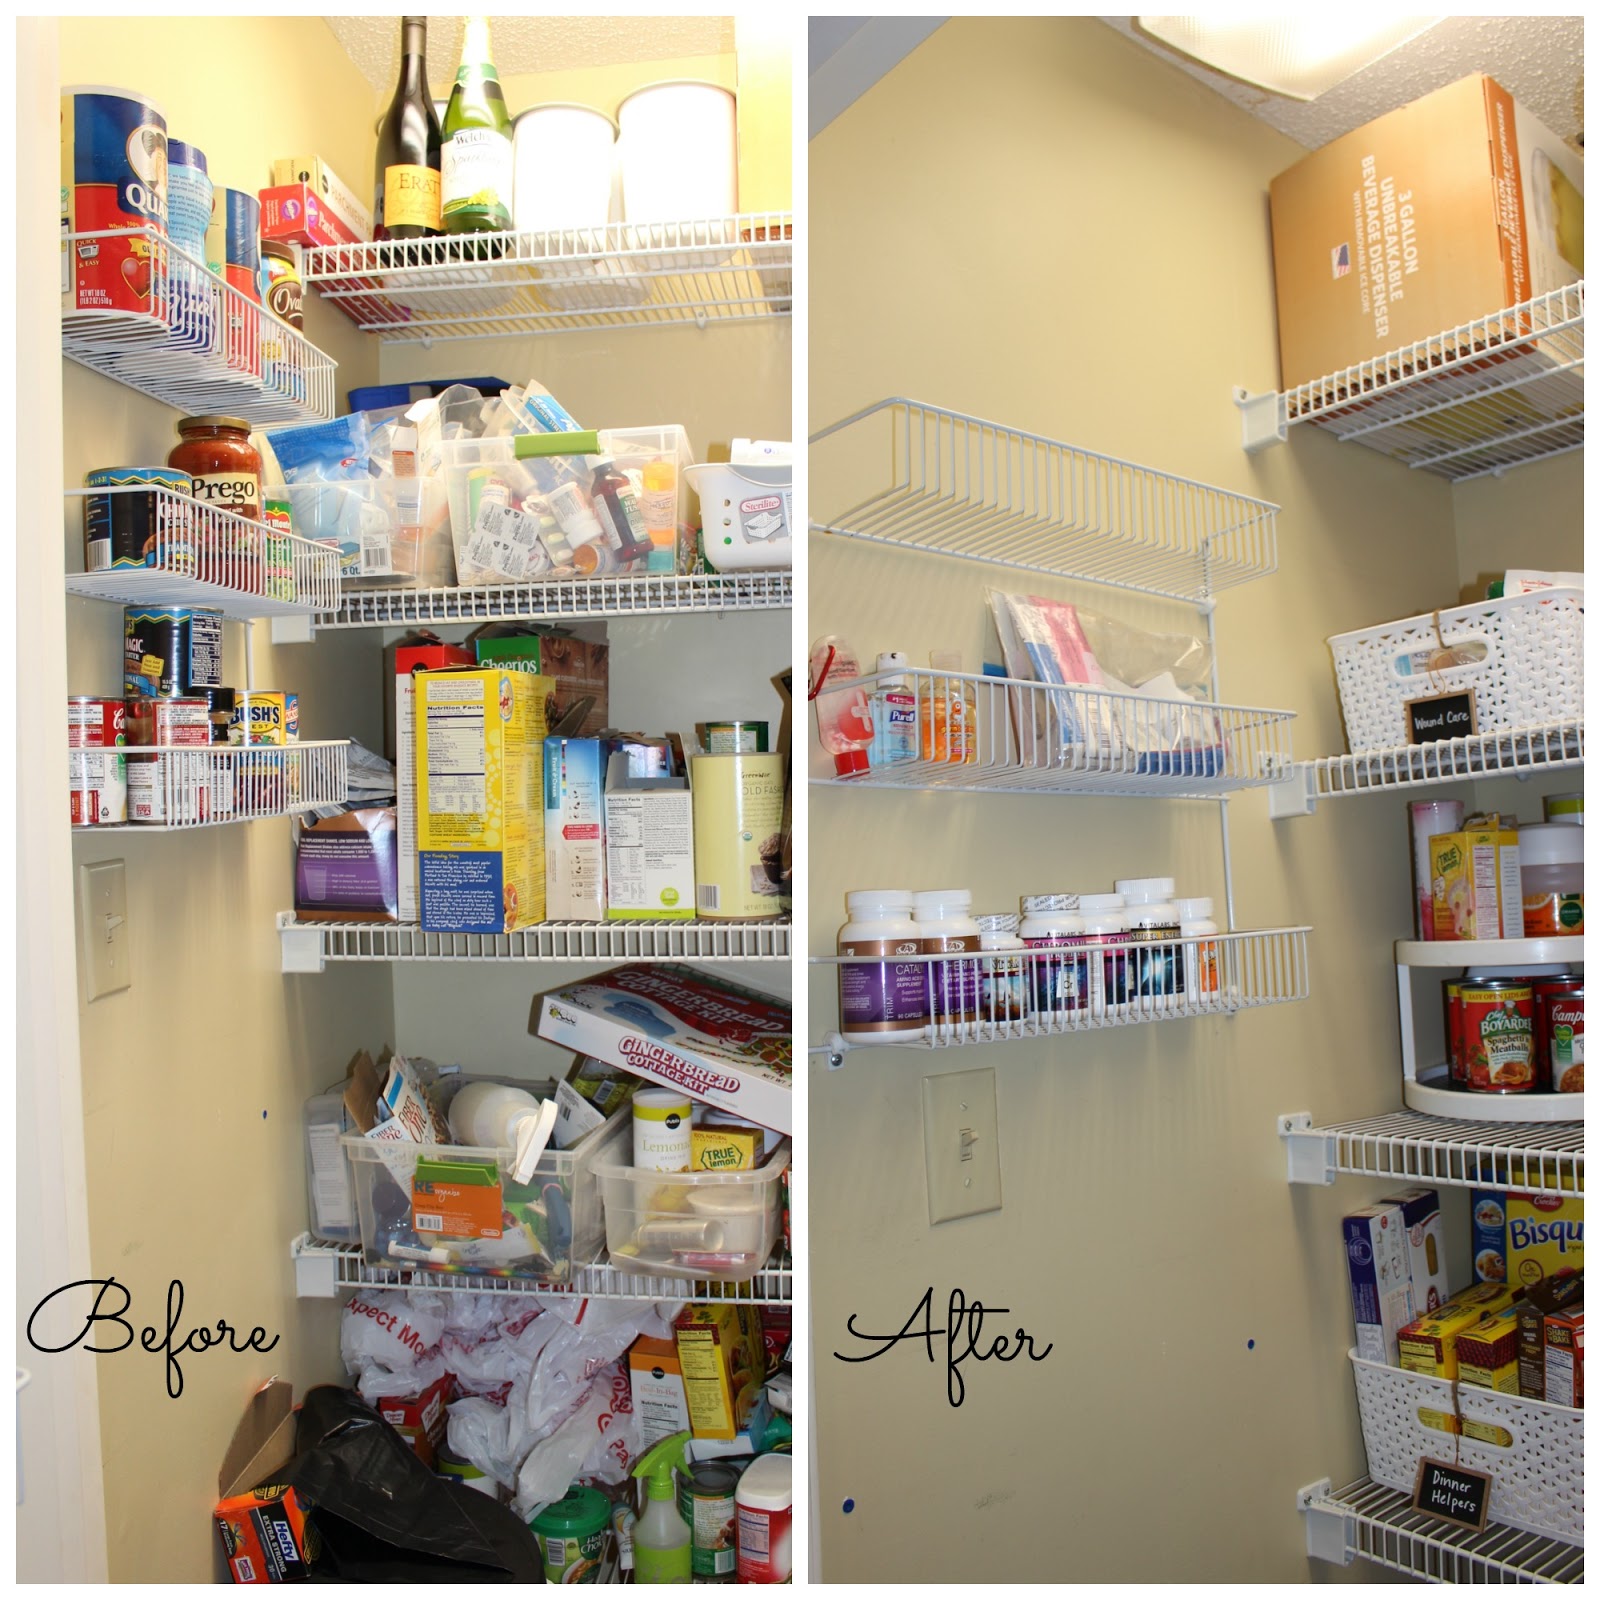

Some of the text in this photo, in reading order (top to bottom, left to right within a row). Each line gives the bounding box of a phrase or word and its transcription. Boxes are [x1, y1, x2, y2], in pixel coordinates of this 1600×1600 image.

[1496, 101, 1510, 168] DISPENSER
[400, 172, 440, 194] ERAT
[1498, 178, 1508, 229] GALLON
[76, 238, 97, 247] QUICK
[1380, 176, 1404, 302] UNBREAKABLE
[1398, 190, 1418, 274] 3 GALLON
[1352, 190, 1370, 315] WITH REMOVABLE ICE CORE
[1361, 154, 1389, 339] BEVERAGE DISPENSER
[192, 478, 254, 505] Prego
[745, 500, 776, 512] Sterilite
[342, 566, 348, 576] 6
[480, 660, 537, 674] Cheerios
[230, 706, 280, 724] BUSH'S
[892, 710, 916, 723] Purell
[1414, 710, 1470, 731] Wound Care
[743, 786, 762, 795] OLD
[1438, 848, 1457, 864] TRUE
[1131, 932, 1158, 940] SUPER
[614, 970, 785, 1032] GINGERBREAD
[617, 978, 735, 1025] COTTAGE KIT
[886, 996, 894, 1020] TRIM
[1486, 1010, 1504, 1020] Chef
[1552, 1004, 1584, 1026] Camp
[1487, 1036, 1525, 1047] Spaghetti
[1490, 1043, 1529, 1054] Meatballs
[618, 1036, 740, 1093] GINGERBREAD
[627, 1052, 710, 1096] COTTAGE KIT
[643, 1140, 691, 1153] Lemona
[706, 1147, 735, 1161] TRUE
[710, 1158, 736, 1168] lemon
[1509, 1216, 1584, 1254] Bisqu
[347, 1298, 427, 1357] xpect Mo
[1546, 1326, 1570, 1336] SHAKE
[1552, 1336, 1571, 1344] BAKE
[1432, 1470, 1472, 1493] Dinner
[1431, 1490, 1477, 1514] Helpers
[220, 1520, 228, 1530] 17
[262, 1516, 276, 1540] EXTRA
[272, 1541, 286, 1572] STRONG
[276, 1523, 294, 1560] Hefty
